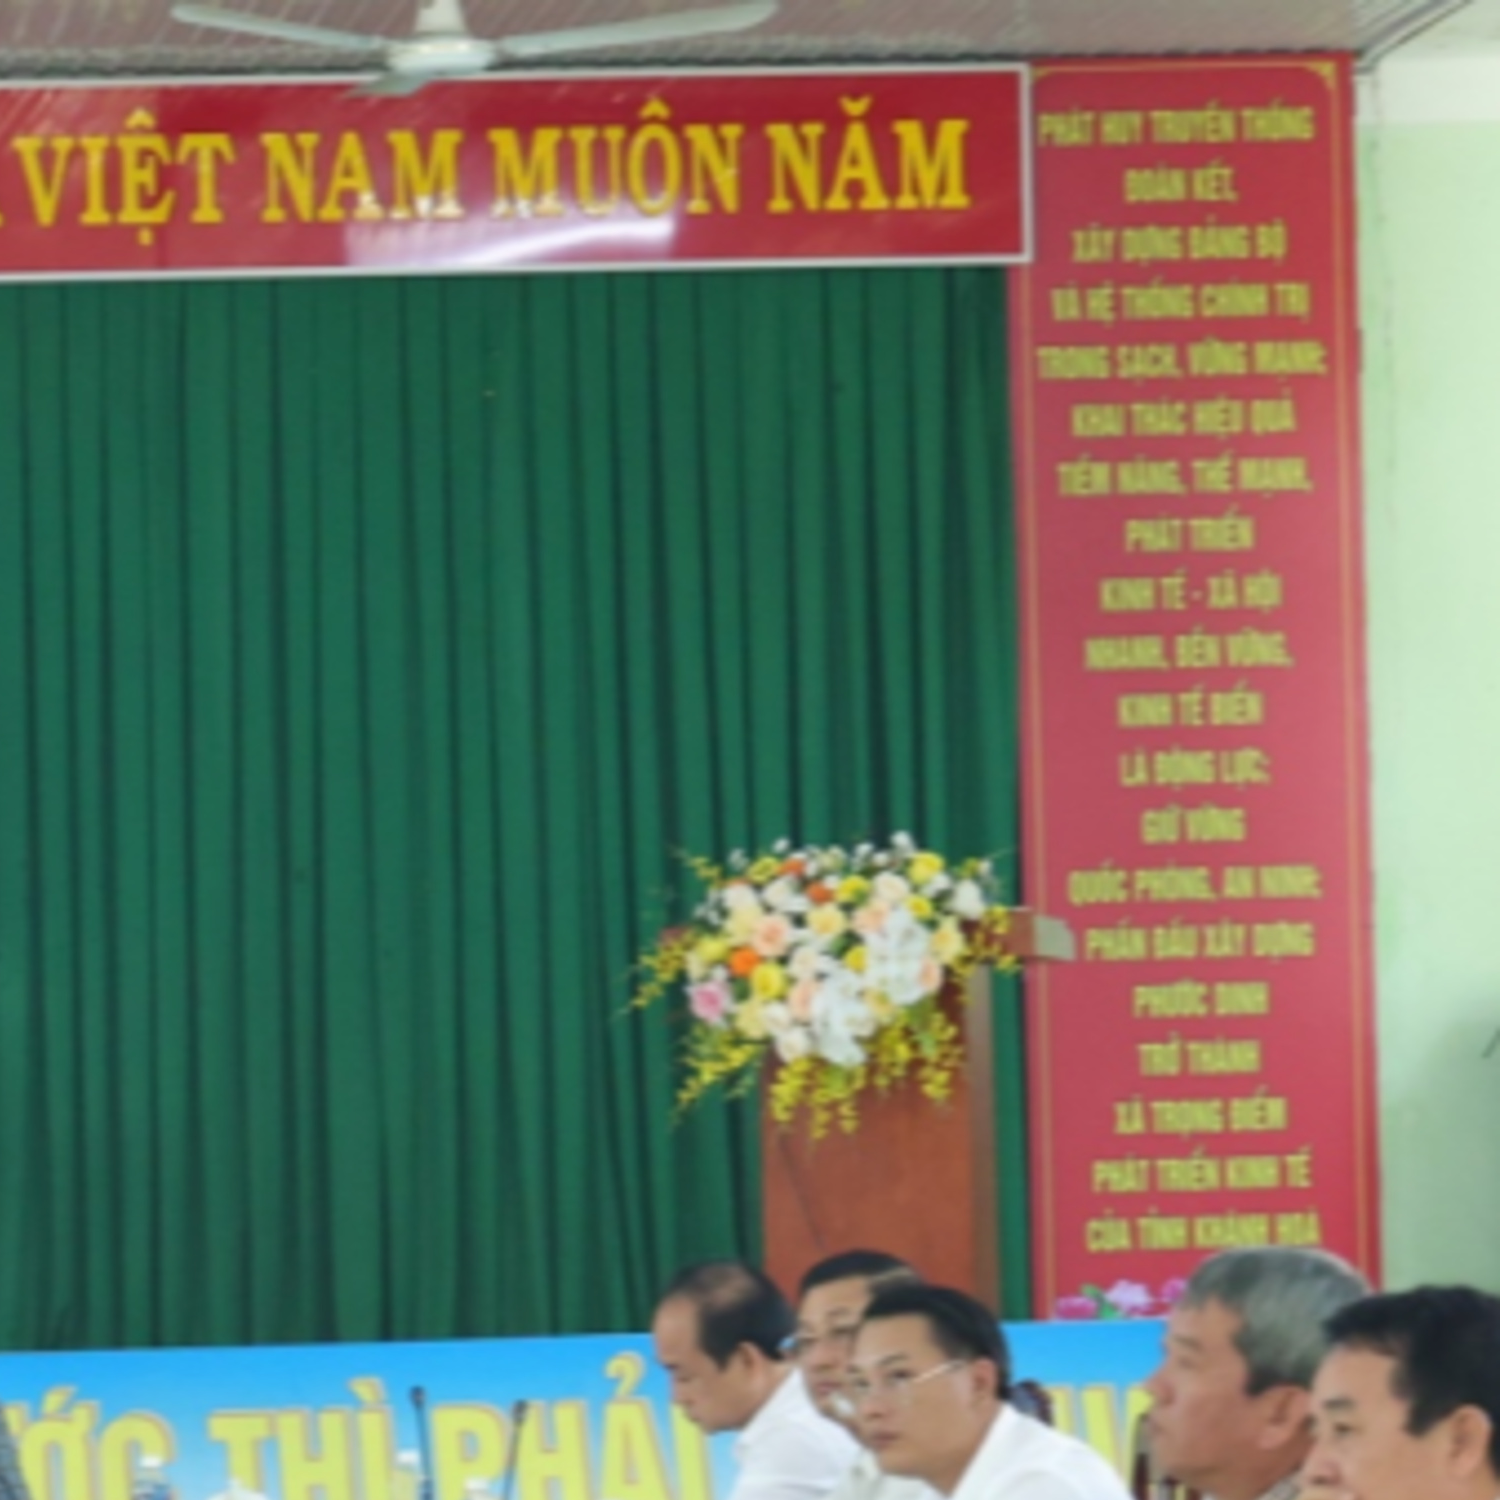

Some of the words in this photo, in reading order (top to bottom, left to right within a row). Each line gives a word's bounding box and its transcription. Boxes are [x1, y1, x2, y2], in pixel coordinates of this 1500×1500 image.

[16, 109, 232, 246] VIỆT
[260, 130, 466, 224] NAM
[490, 99, 744, 217] MUÔN
[766, 96, 972, 212] NĂM
